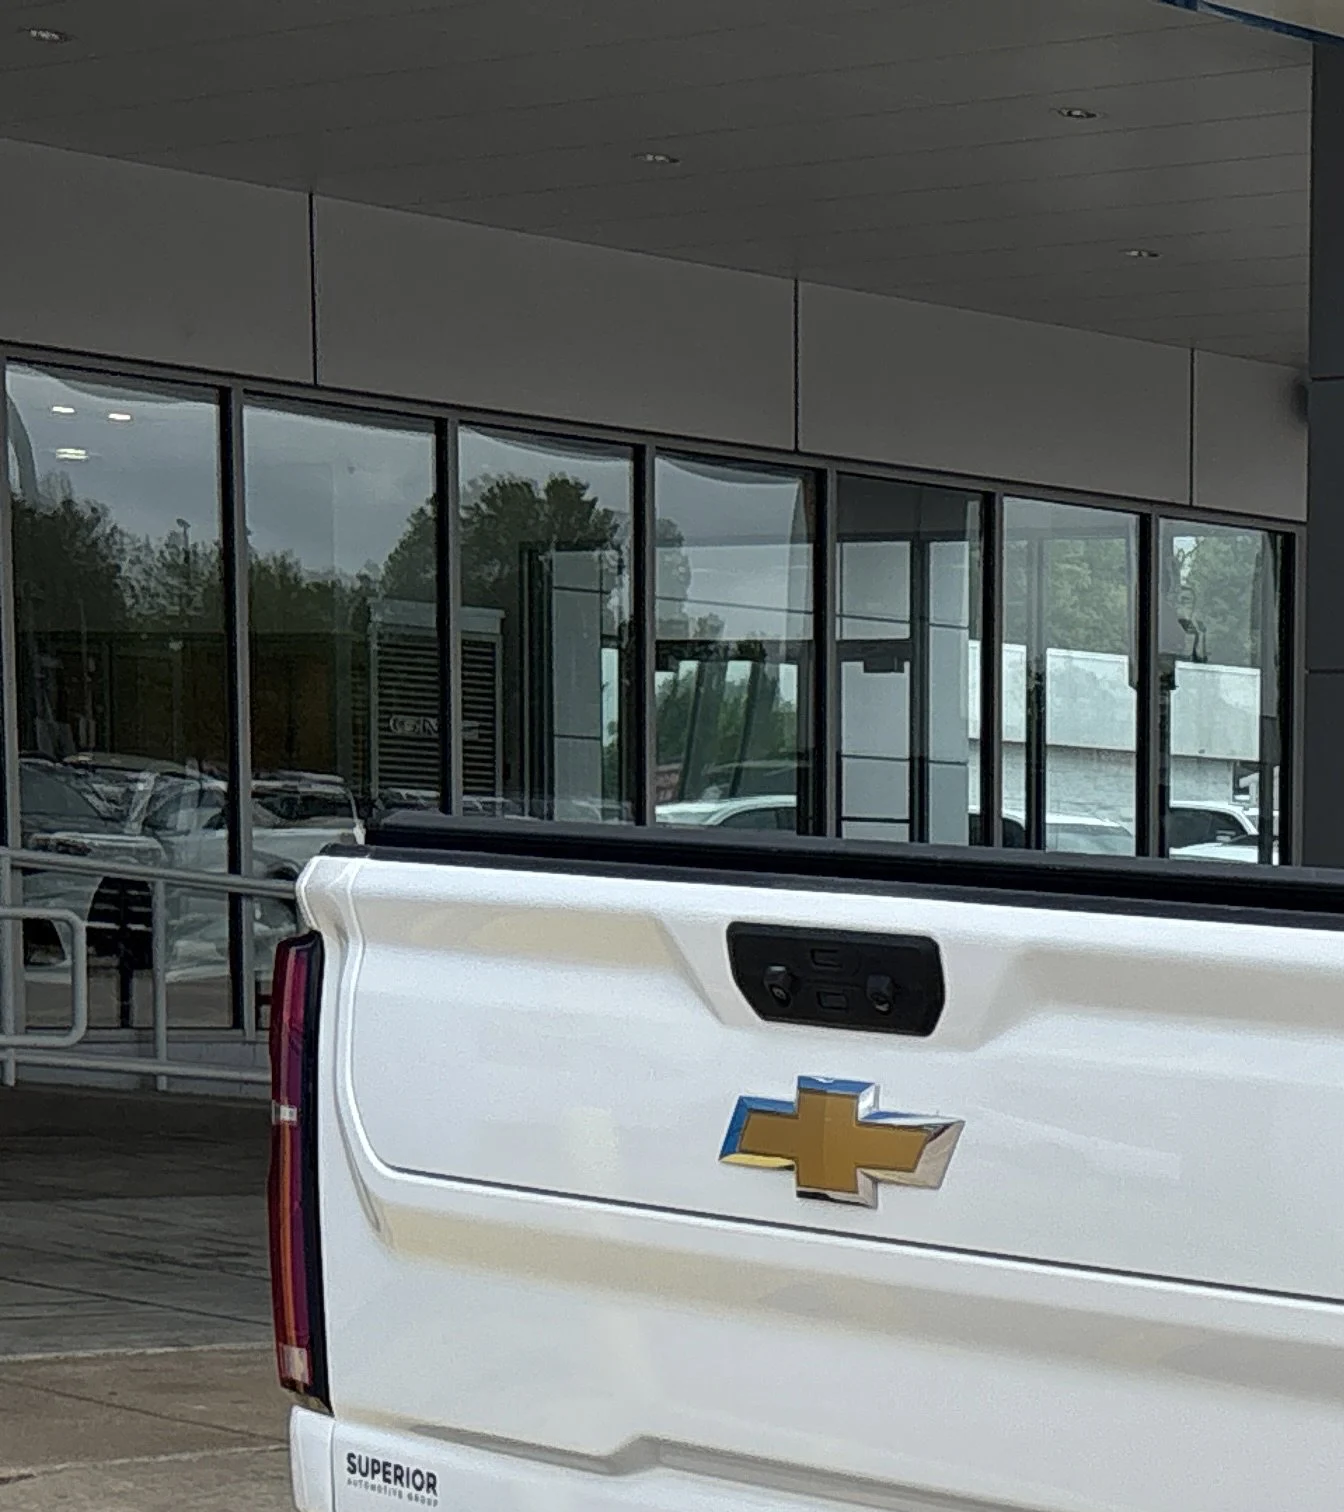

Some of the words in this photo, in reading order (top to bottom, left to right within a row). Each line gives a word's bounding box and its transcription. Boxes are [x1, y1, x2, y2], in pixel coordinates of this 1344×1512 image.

[346, 1452, 438, 1497] SUPERIOR
[347, 1478, 404, 1499] AUTOMOTIVE
[407, 1492, 439, 1507] GROUP
